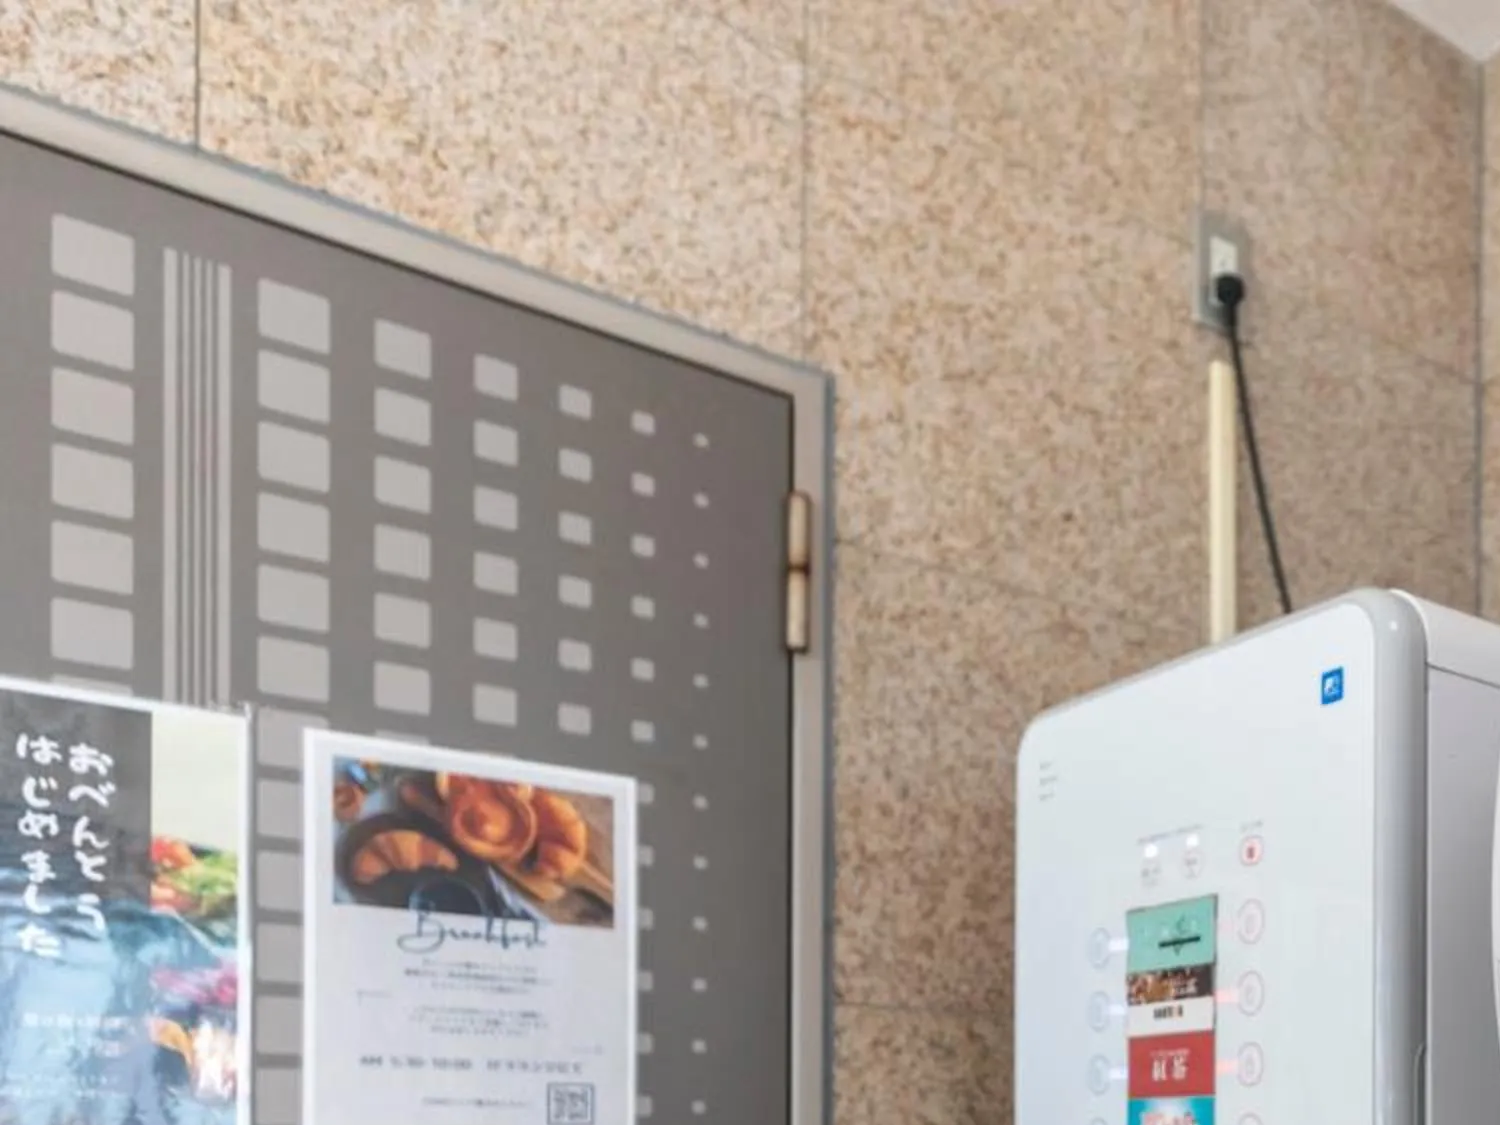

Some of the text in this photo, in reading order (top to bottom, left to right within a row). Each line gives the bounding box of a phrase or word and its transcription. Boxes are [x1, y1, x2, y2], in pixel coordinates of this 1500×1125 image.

[16, 733, 62, 957] はじめました
[67, 742, 116, 932] おべんとう
